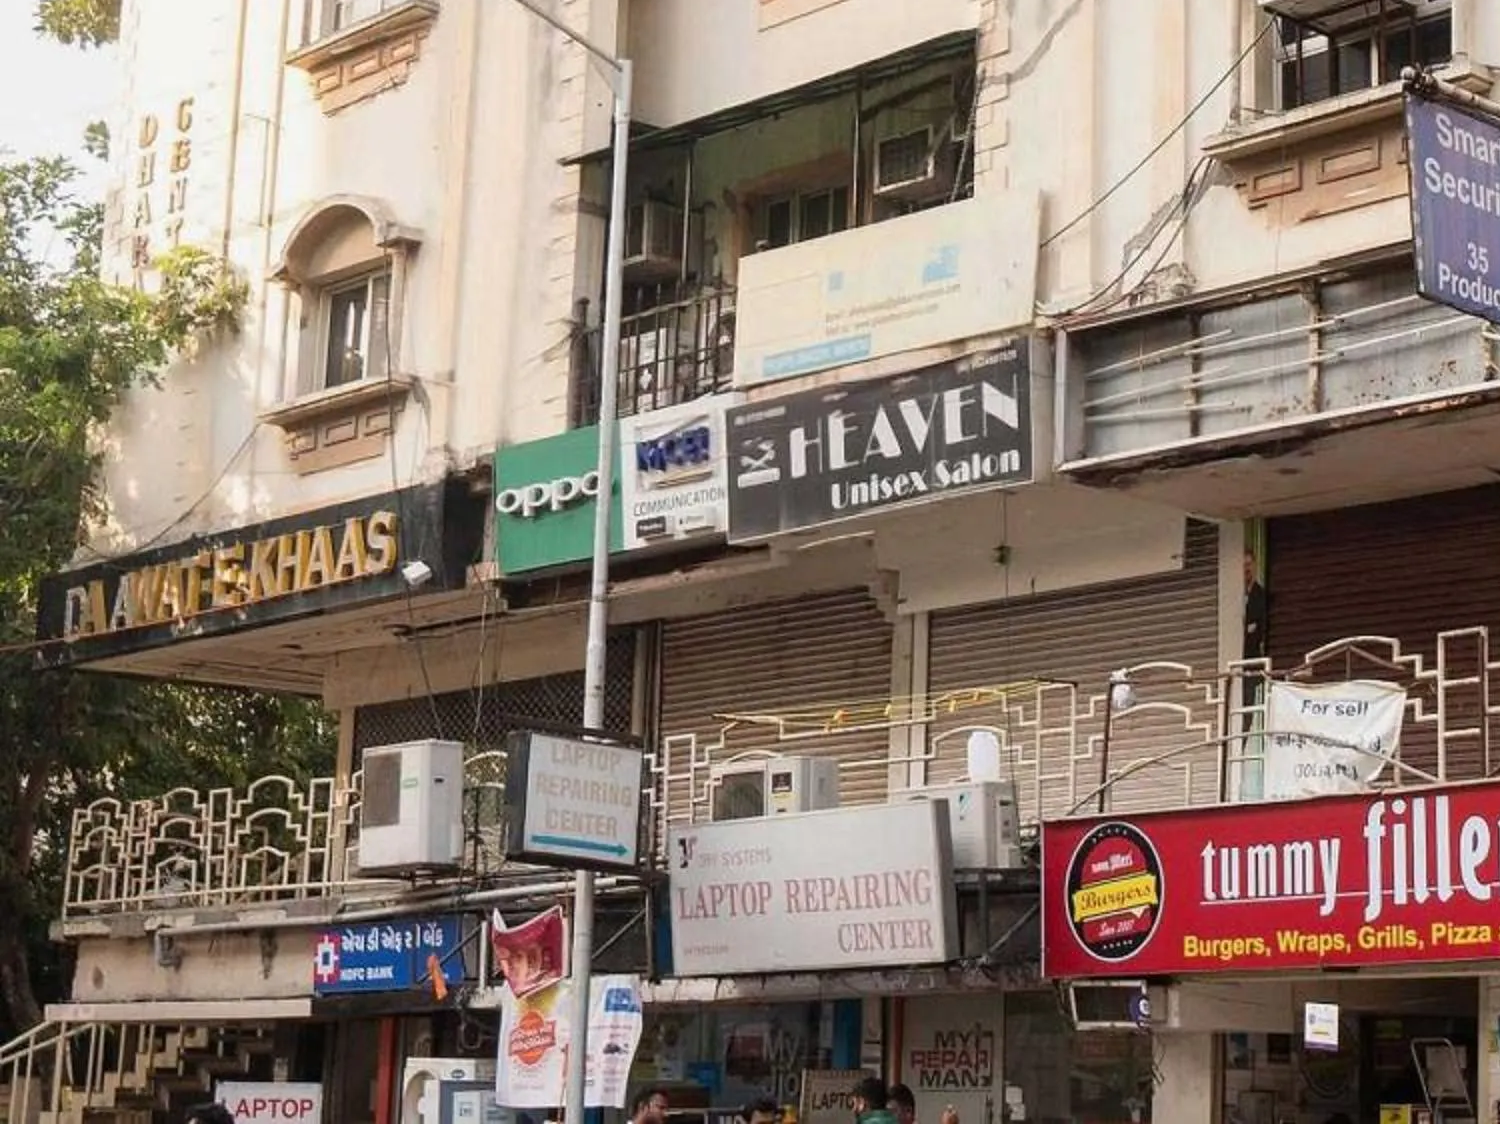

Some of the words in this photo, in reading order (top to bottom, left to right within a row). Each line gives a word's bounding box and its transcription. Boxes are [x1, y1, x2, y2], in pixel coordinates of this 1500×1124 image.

[1467, 241, 1489, 274] 35
[789, 373, 1020, 479] HEAVEN
[831, 468, 930, 511] Unisex
[934, 448, 1021, 489] Salon
[1301, 699, 1328, 715] For
[1335, 701, 1369, 717] sell
[551, 741, 622, 773] LAPTOP
[545, 807, 618, 840] CENTER
[1200, 838, 1341, 916] tummy
[678, 881, 772, 921] LAPTOP
[784, 869, 931, 914] REPAIRING
[837, 918, 934, 953] CENTER
[1183, 935, 1271, 960] Burgers,
[1277, 929, 1351, 954] Wraps,
[1358, 925, 1424, 952] Grills,
[1431, 921, 1491, 946] Pizza
[223, 1097, 313, 1118] APTOP
